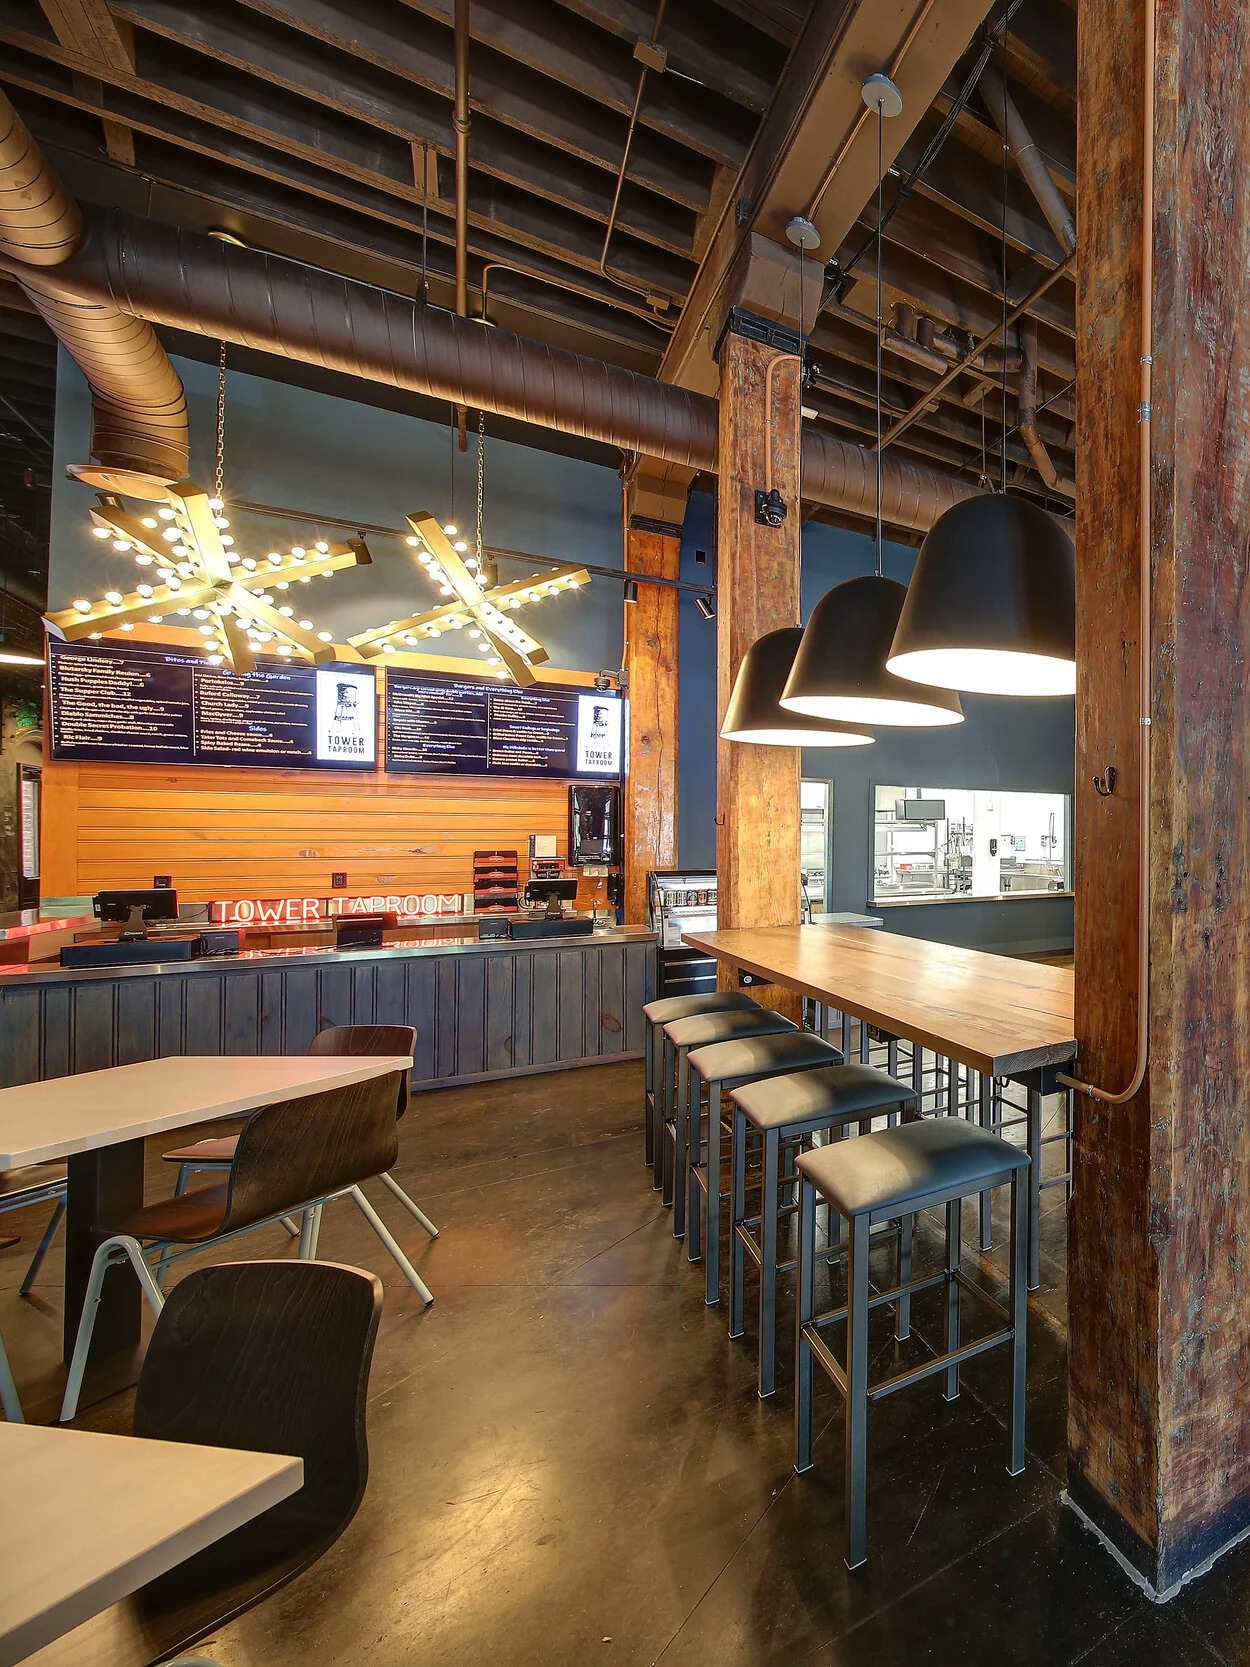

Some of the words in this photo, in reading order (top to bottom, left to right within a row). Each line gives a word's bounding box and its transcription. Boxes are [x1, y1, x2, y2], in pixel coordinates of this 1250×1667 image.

[328, 736, 364, 746] TOWER
[585, 751, 612, 759] TOWER
[214, 898, 320, 922] TOWER
[332, 894, 459, 914] TAPROOM
